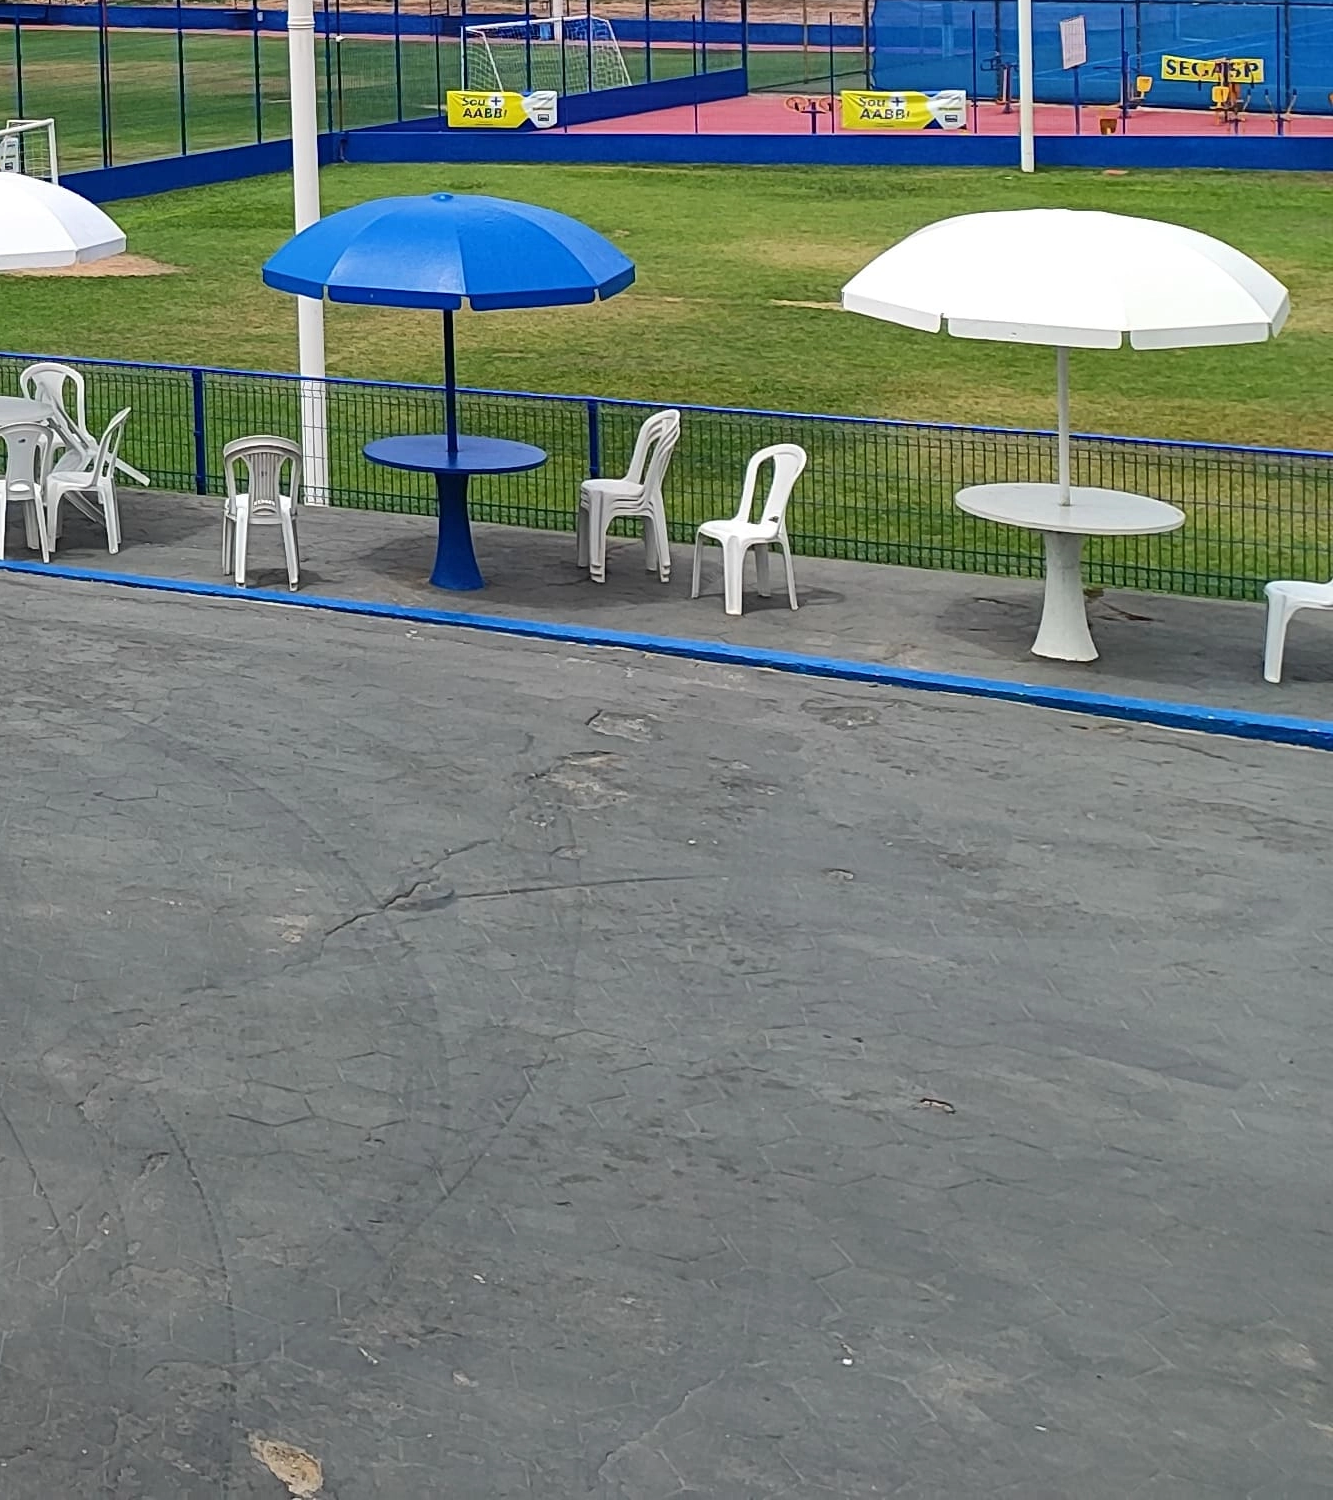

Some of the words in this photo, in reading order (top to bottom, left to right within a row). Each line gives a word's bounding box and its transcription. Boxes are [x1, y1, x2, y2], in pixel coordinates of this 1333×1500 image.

[462, 97, 485, 107] Sou
[859, 97, 885, 107] Sou
[462, 108, 507, 119] AABB!
